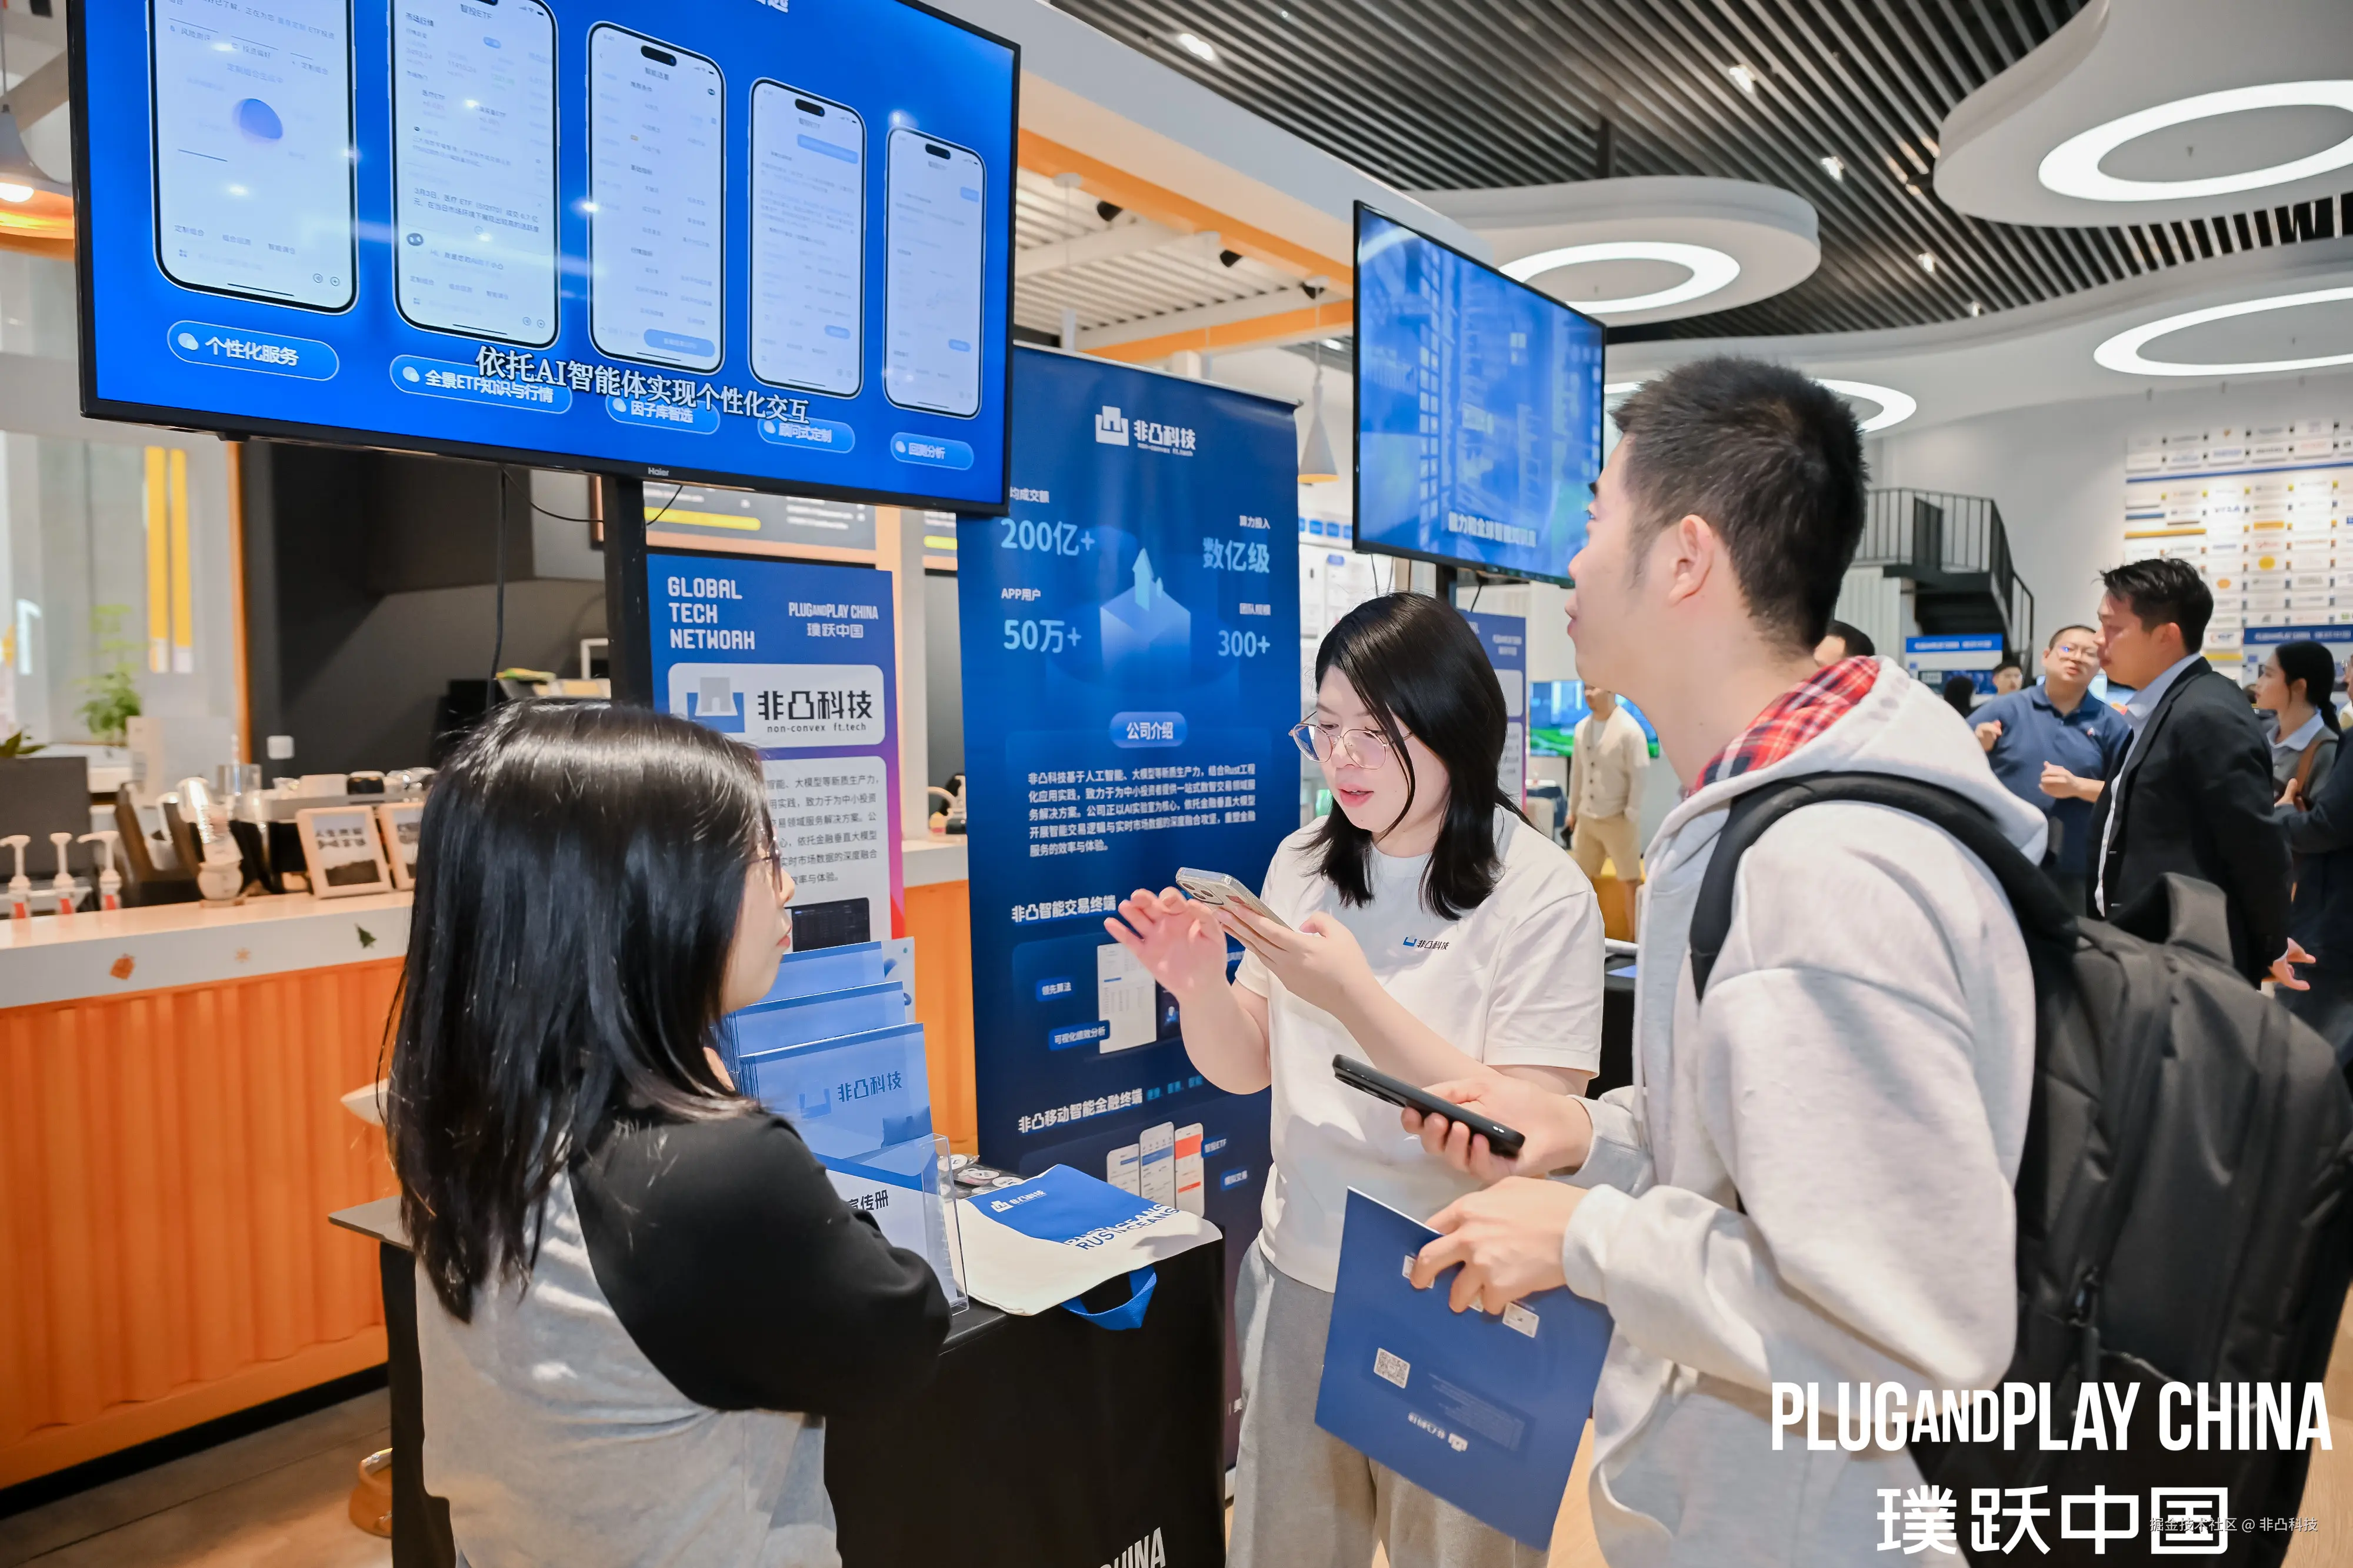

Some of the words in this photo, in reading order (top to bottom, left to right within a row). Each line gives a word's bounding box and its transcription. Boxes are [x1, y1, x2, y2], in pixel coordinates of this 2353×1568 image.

[459, 198, 473, 206] ETF
[205, 336, 299, 366] 个性化服务
[425, 370, 554, 403] 全景ETF知识与行情
[475, 345, 809, 424] 依托AI智能体实现个性化交互
[631, 401, 694, 424] 因子库智选
[1134, 419, 1197, 451] 非凸科技
[1001, 518, 1095, 556] 200亿+
[1203, 536, 1270, 574] 数亿级
[667, 576, 742, 600] GLOBAL
[1001, 588, 1041, 602] APP用户
[668, 602, 718, 624] TECH
[850, 604, 879, 620] CHINA
[806, 622, 864, 639] 璞跃中国
[1004, 619, 1082, 653] 50万+
[1218, 630, 1270, 658] 300+
[757, 690, 873, 720] 非凸科技
[767, 725, 826, 733] non-convex
[1126, 722, 1174, 740] 公司介绍
[1029, 839, 1108, 857] 服务的效率与体验。
[1011, 895, 1116, 923] 非凸智能交易终端
[1417, 939, 1449, 951] 非凸科技
[837, 1070, 903, 1103] 非凸科技
[1018, 1087, 1143, 1133] 非凸移动智能金融终端
